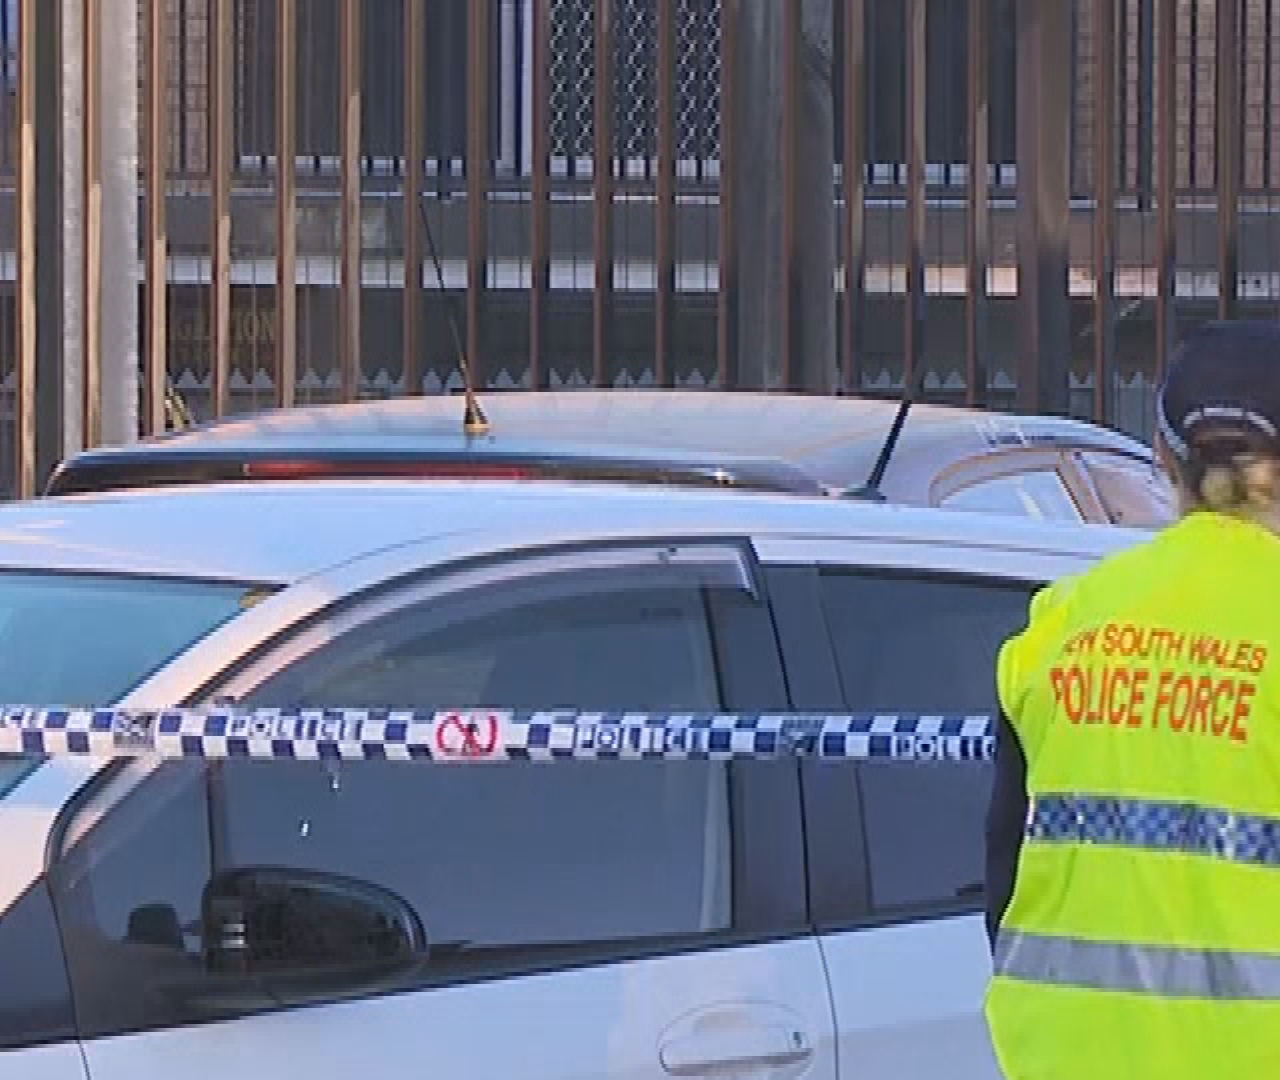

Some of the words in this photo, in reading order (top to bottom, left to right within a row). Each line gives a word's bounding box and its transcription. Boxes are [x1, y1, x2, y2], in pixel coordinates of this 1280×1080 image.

[1102, 622, 1185, 658] SOUTH
[1189, 633, 1268, 674] WALES
[1050, 662, 1149, 728] POLICE
[1152, 671, 1257, 744] FORCE
[226, 709, 366, 743] POLICE
[575, 722, 709, 755] POLICE
[890, 734, 997, 762] POLIC
